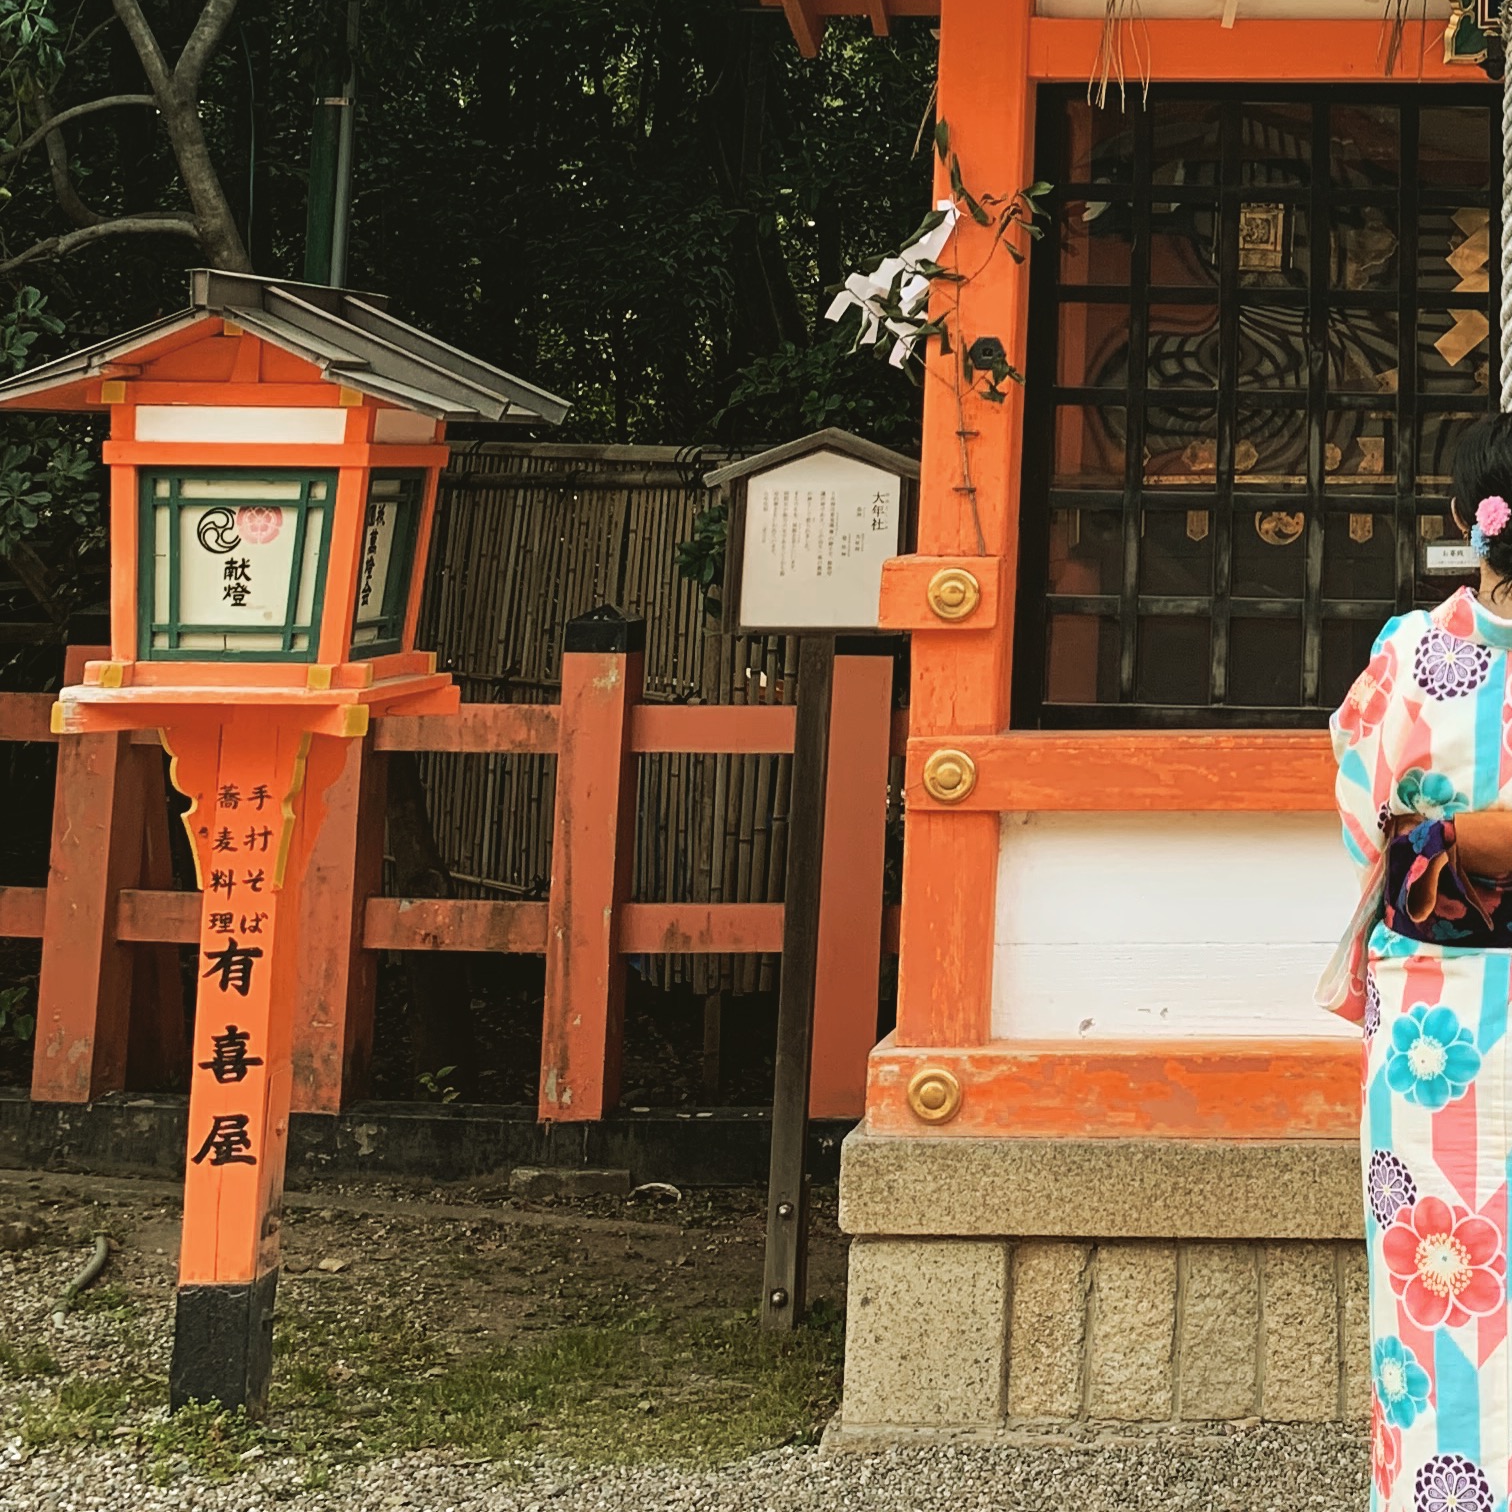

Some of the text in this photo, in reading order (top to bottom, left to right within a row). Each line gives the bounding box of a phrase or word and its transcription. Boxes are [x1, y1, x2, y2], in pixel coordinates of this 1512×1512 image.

[222, 557, 252, 607] 献燈
[872, 491, 886, 531] 大年社
[208, 785, 242, 934] 蕎麦料理
[239, 784, 274, 934] 手打そば
[191, 938, 264, 1167] 有喜屋
